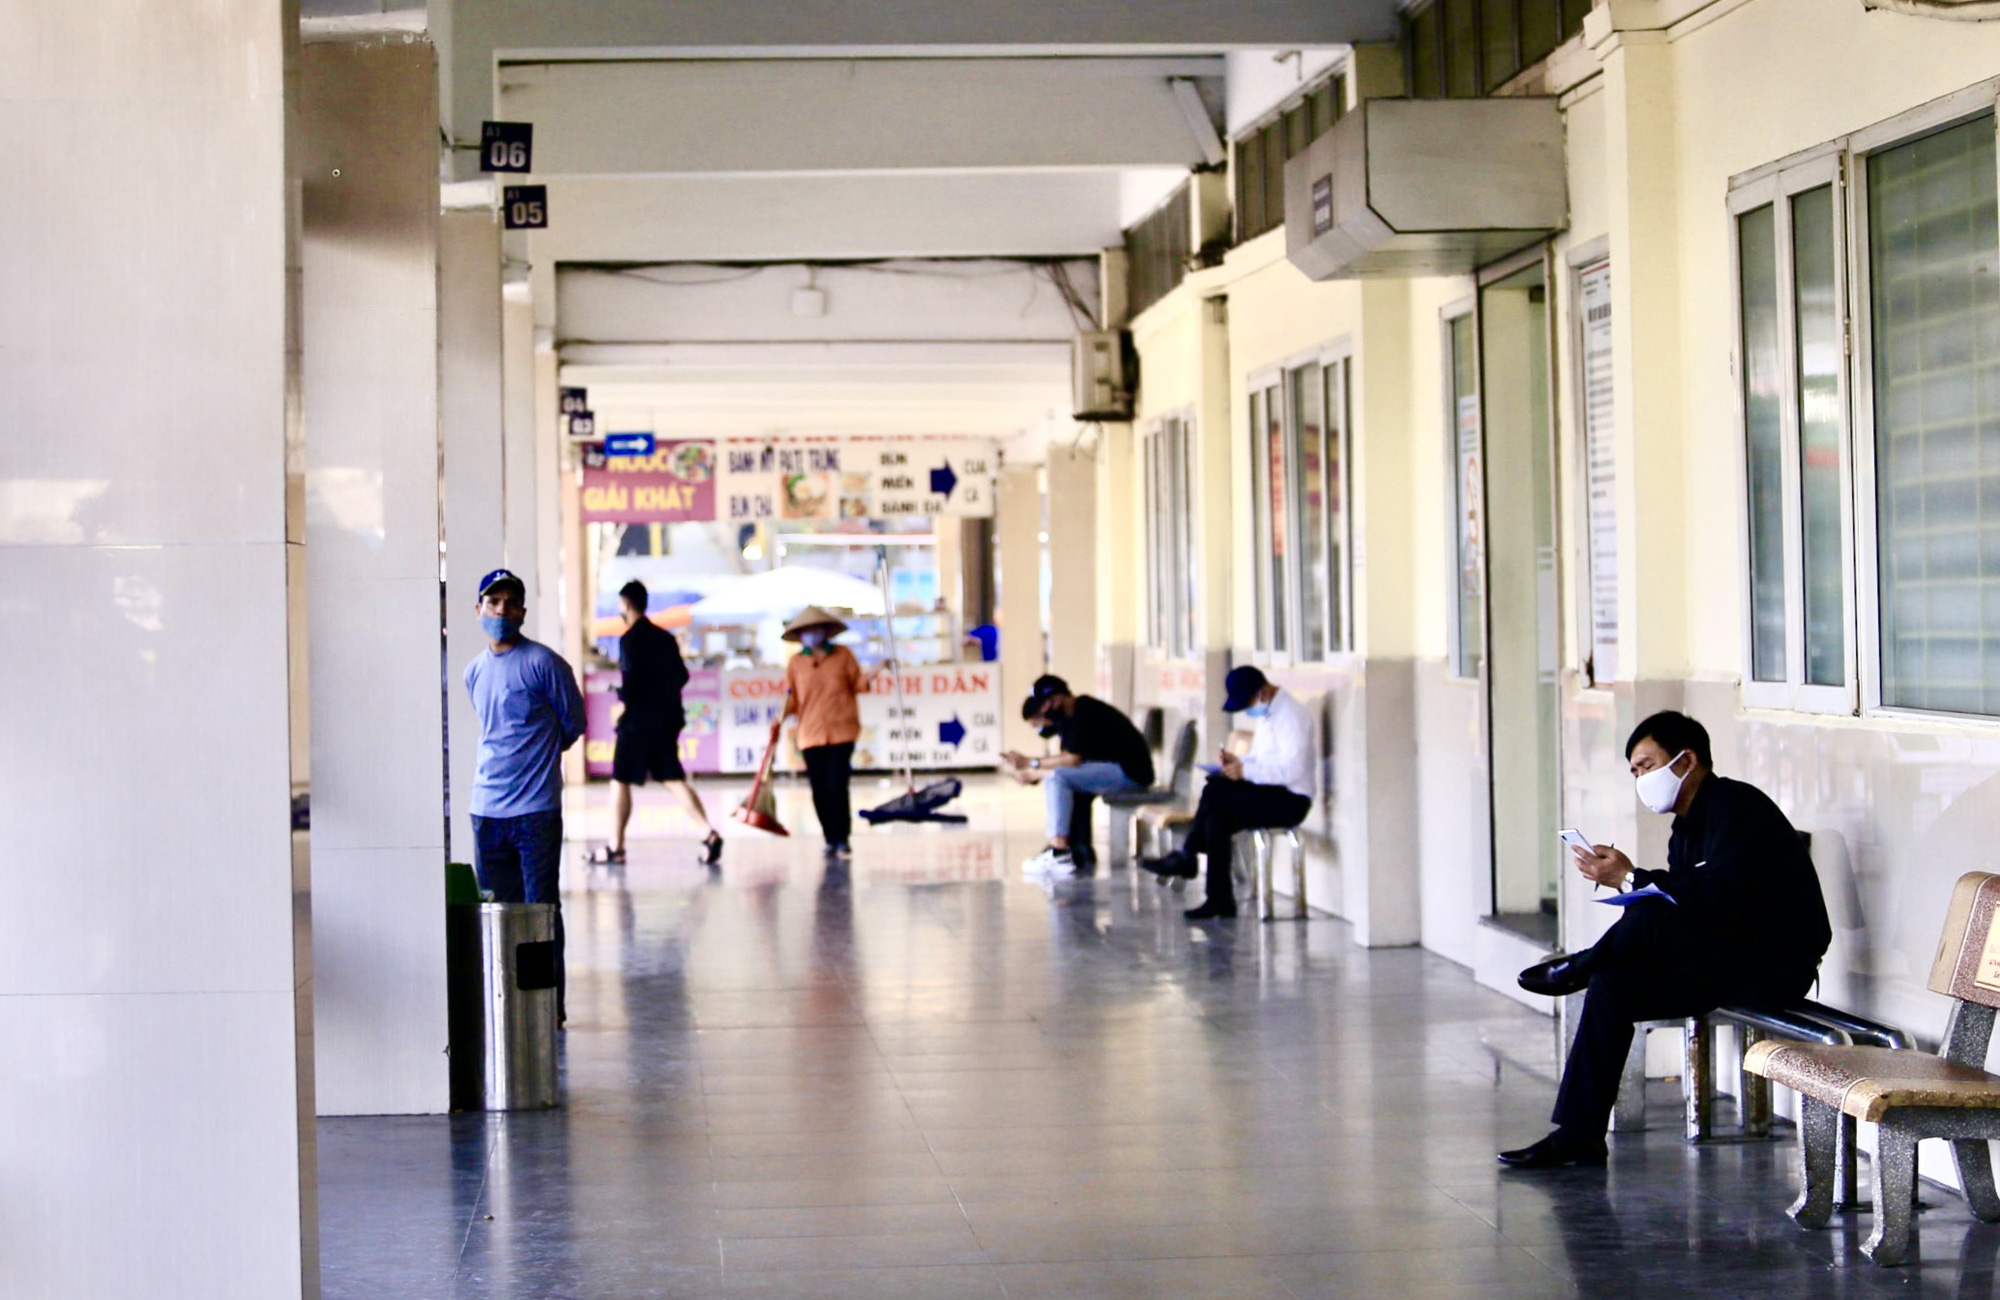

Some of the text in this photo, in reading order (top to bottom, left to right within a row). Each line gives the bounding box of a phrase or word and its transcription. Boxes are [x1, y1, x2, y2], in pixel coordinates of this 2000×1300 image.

[490, 141, 527, 168] 06
[512, 201, 543, 225] 05
[633, 480, 696, 512] KHÁT
